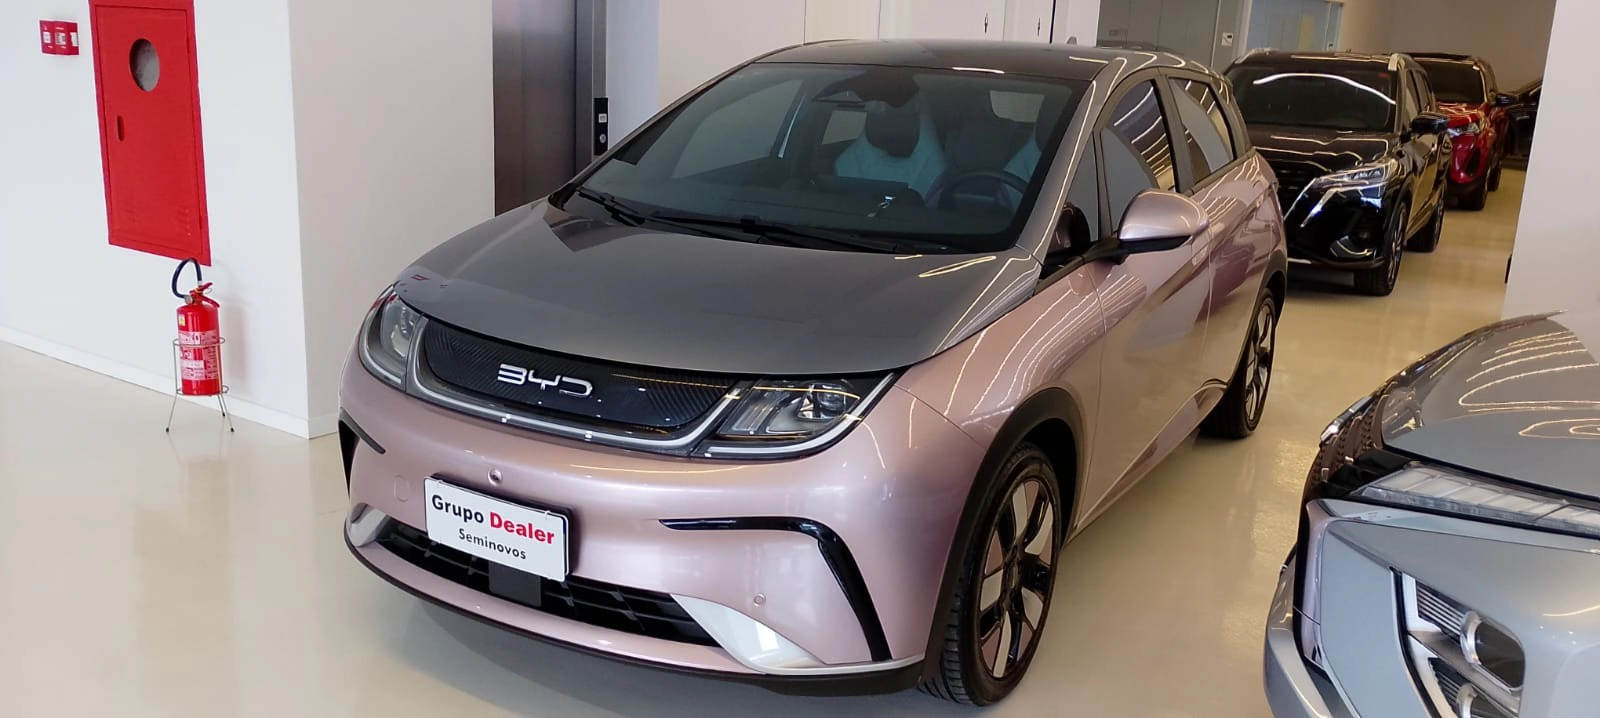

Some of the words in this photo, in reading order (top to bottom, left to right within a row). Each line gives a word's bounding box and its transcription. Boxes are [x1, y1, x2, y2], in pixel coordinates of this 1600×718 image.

[497, 363, 593, 397] BYD
[431, 494, 484, 523] Grupo
[489, 511, 555, 544] Dealer
[458, 528, 527, 560] Seminovos
